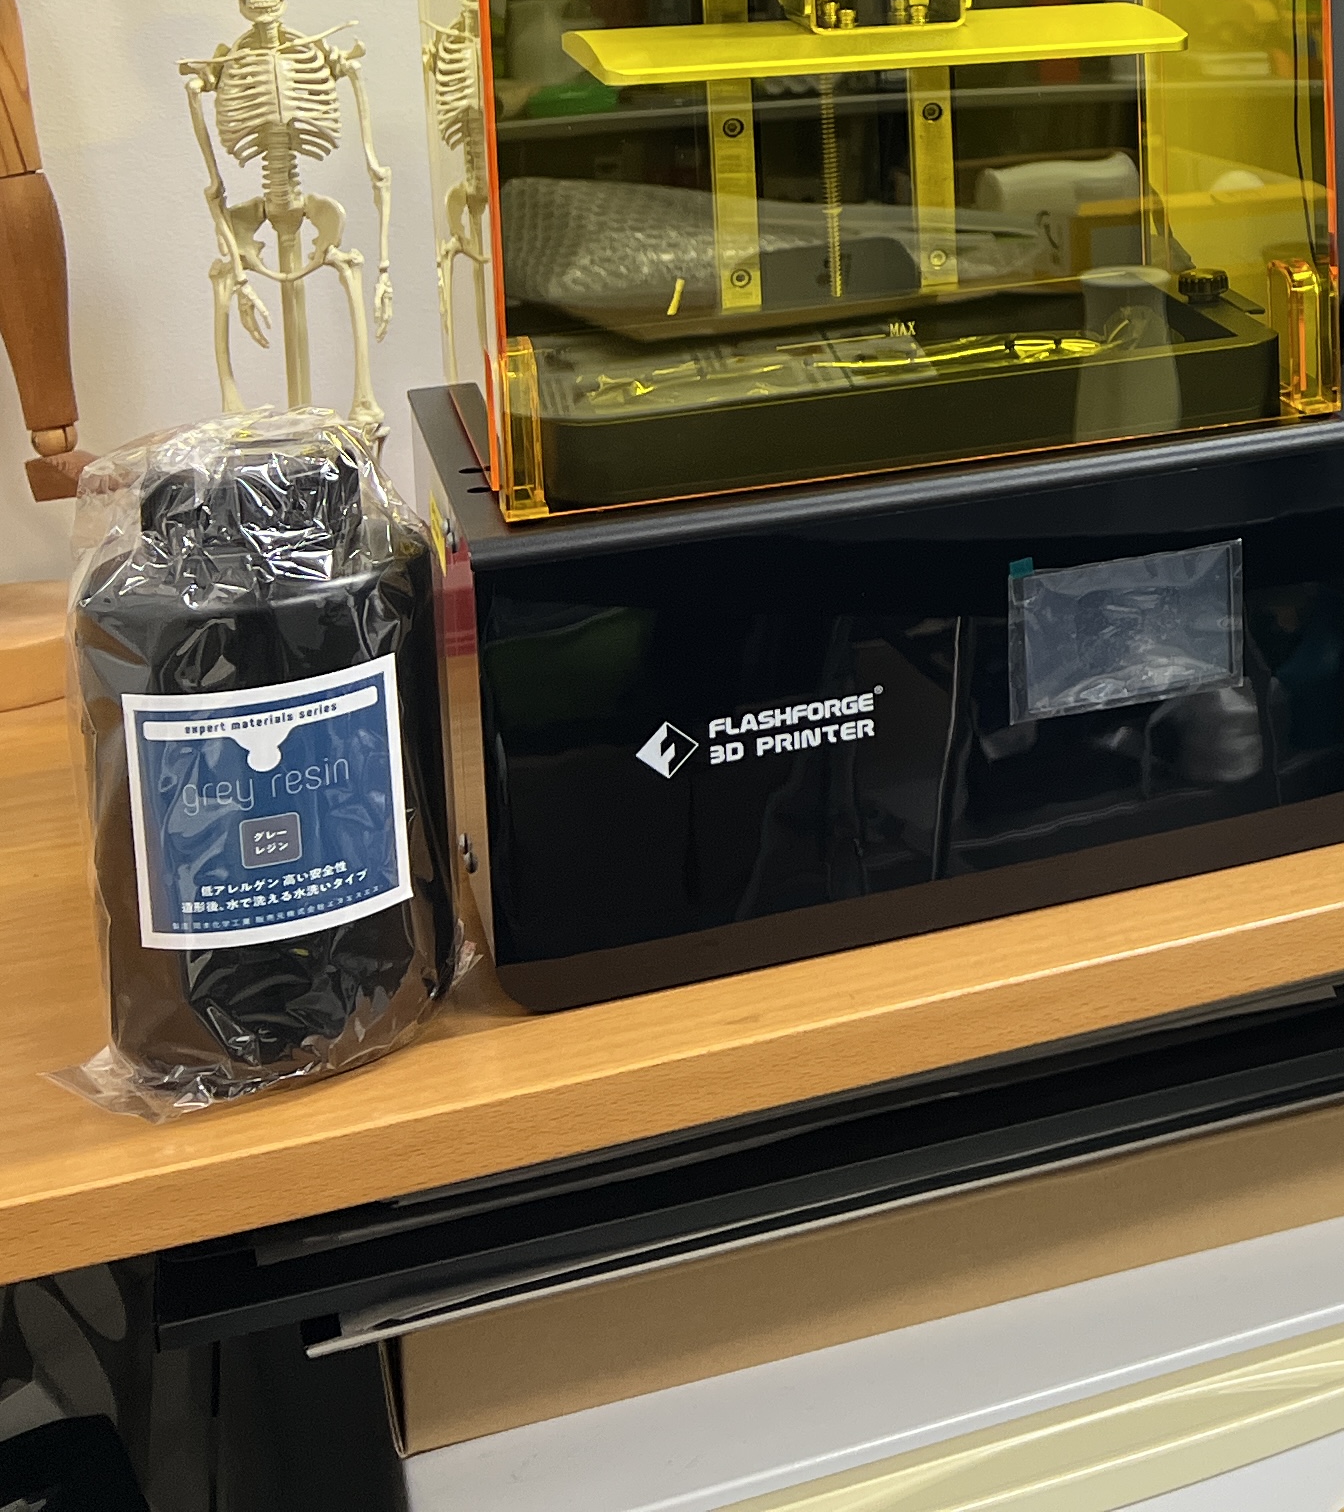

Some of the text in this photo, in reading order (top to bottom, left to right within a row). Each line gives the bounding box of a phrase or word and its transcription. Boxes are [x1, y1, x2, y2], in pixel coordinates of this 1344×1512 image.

[889, 320, 916, 337] MAX
[184, 702, 338, 735] expert materials series
[708, 692, 875, 738] FLASHFORGE
[709, 718, 875, 765] 3D PRINTER
[182, 757, 350, 816] grey resin
[254, 828, 288, 842] グレー
[254, 841, 289, 855] レジン
